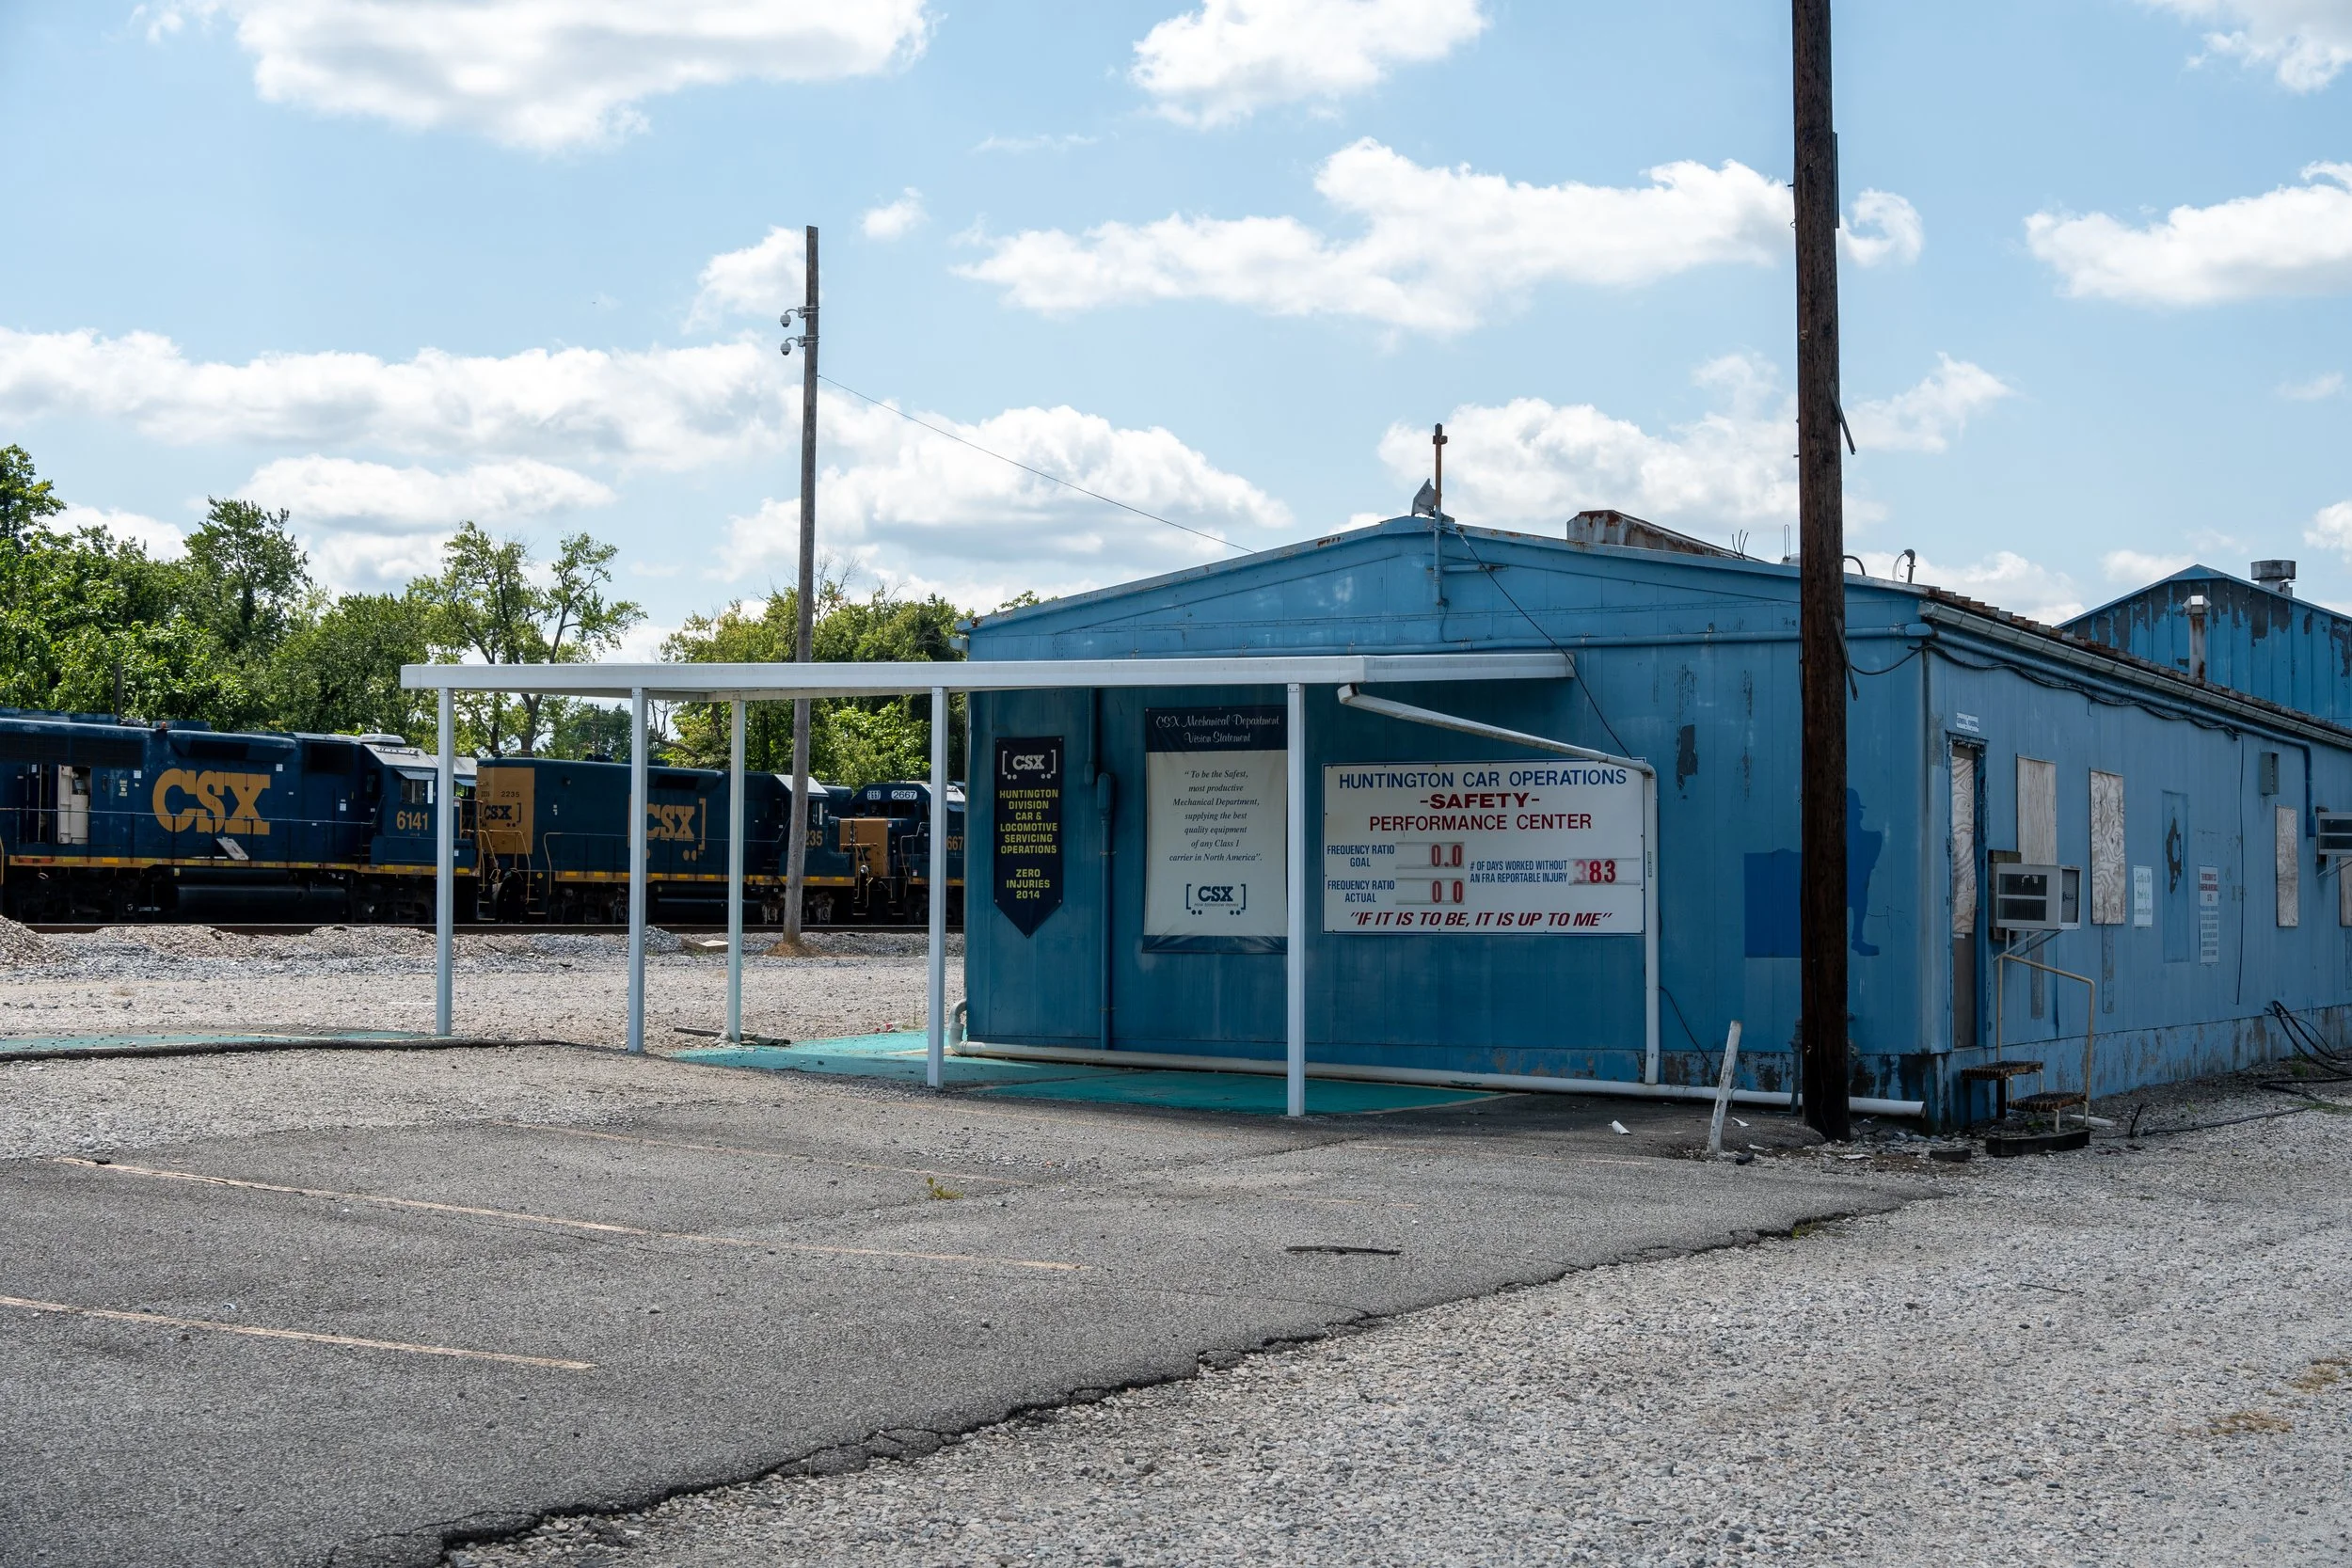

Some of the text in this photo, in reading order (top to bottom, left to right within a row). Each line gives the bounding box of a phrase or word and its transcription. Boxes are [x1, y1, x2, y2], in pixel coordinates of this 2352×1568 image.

[1155, 714, 1279, 729] CSX Mechanical Department
[1184, 731, 1251, 744] Vision Statement
[1012, 754, 1045, 770] CSX
[1224, 769, 1248, 779] Safest,
[1339, 768, 1627, 789] HUNTINGTON CAR OPERATIONS
[999, 789, 1058, 799] HUNTINGTON
[1206, 784, 1244, 794] productive
[893, 791, 916, 800] 2667
[152, 768, 271, 835] CSX
[1009, 800, 1049, 810] DIVISION
[1172, 798, 1260, 807] Mechanical Department,
[484, 804, 512, 820] CSX
[1015, 812, 1041, 821] CAR &
[1184, 811, 1248, 821] supplying the best
[396, 810, 428, 831] 6141
[646, 803, 695, 842] CSX
[1370, 814, 1592, 832] PERFORMANCE CENTER
[1000, 823, 1057, 832] LOCOMOTIVE
[1184, 825, 1248, 835] quality equipment
[1004, 833, 1053, 843] SERVICING
[1190, 839, 1200, 848] of
[1215, 839, 1233, 847] Class
[1000, 845, 1057, 854] OPERATIONS
[1327, 845, 1395, 855] FREQUENCY RATIO
[1168, 853, 1194, 862] carrier
[1202, 852, 1224, 862] North
[1431, 844, 1463, 867] 0.0
[1349, 857, 1371, 867] GOAL
[1470, 860, 1567, 871] # OF DAYS WORKED WITHOUT
[1016, 868, 1041, 878] ZERO
[1573, 859, 1616, 884] 383
[1470, 872, 1568, 883] AN FRA REPORTABLE INJURY
[1006, 879, 1051, 888] INJURIES
[1327, 879, 1395, 890] FREQUENCY RATIO
[1016, 890, 1041, 899] 2014
[1198, 885, 1233, 902] CSX
[1344, 893, 1377, 903] ACTUAL
[1375, 911, 1394, 926] IT
[1395, 911, 1414, 926] IS
[1420, 911, 1442, 926] TO
[1444, 911, 1470, 927] BE,
[1474, 912, 1494, 927] IT
[1496, 912, 1515, 927] IS
[1518, 912, 1543, 927] UP
[1548, 912, 1571, 927] TO
